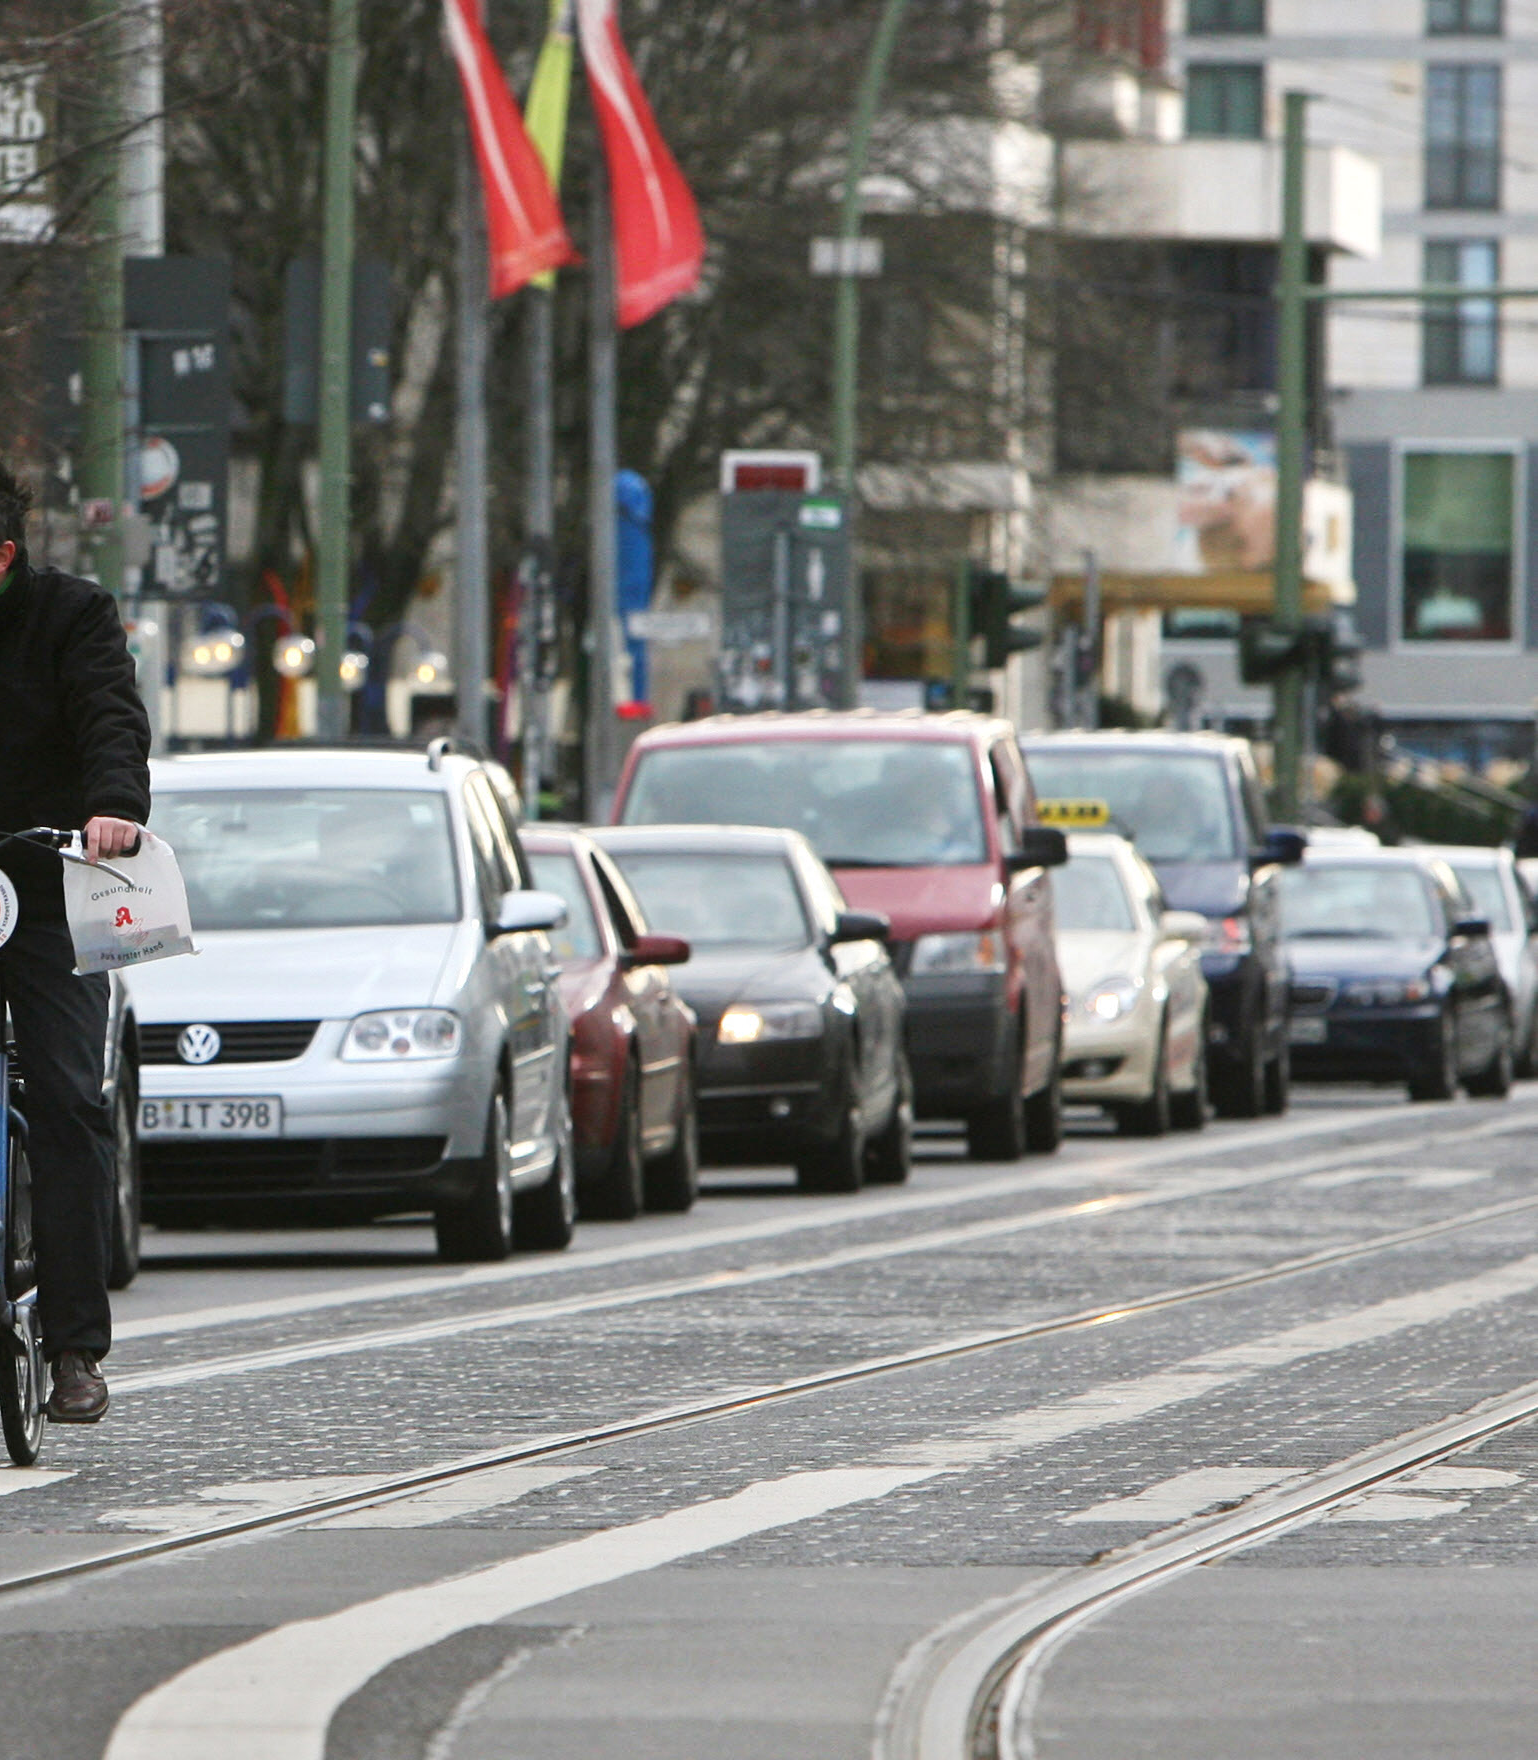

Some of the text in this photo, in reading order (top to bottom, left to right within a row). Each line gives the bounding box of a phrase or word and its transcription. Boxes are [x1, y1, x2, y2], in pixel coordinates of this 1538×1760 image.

[90, 884, 153, 901] Gesundheit
[143, 1102, 271, 1129] B IT 398
